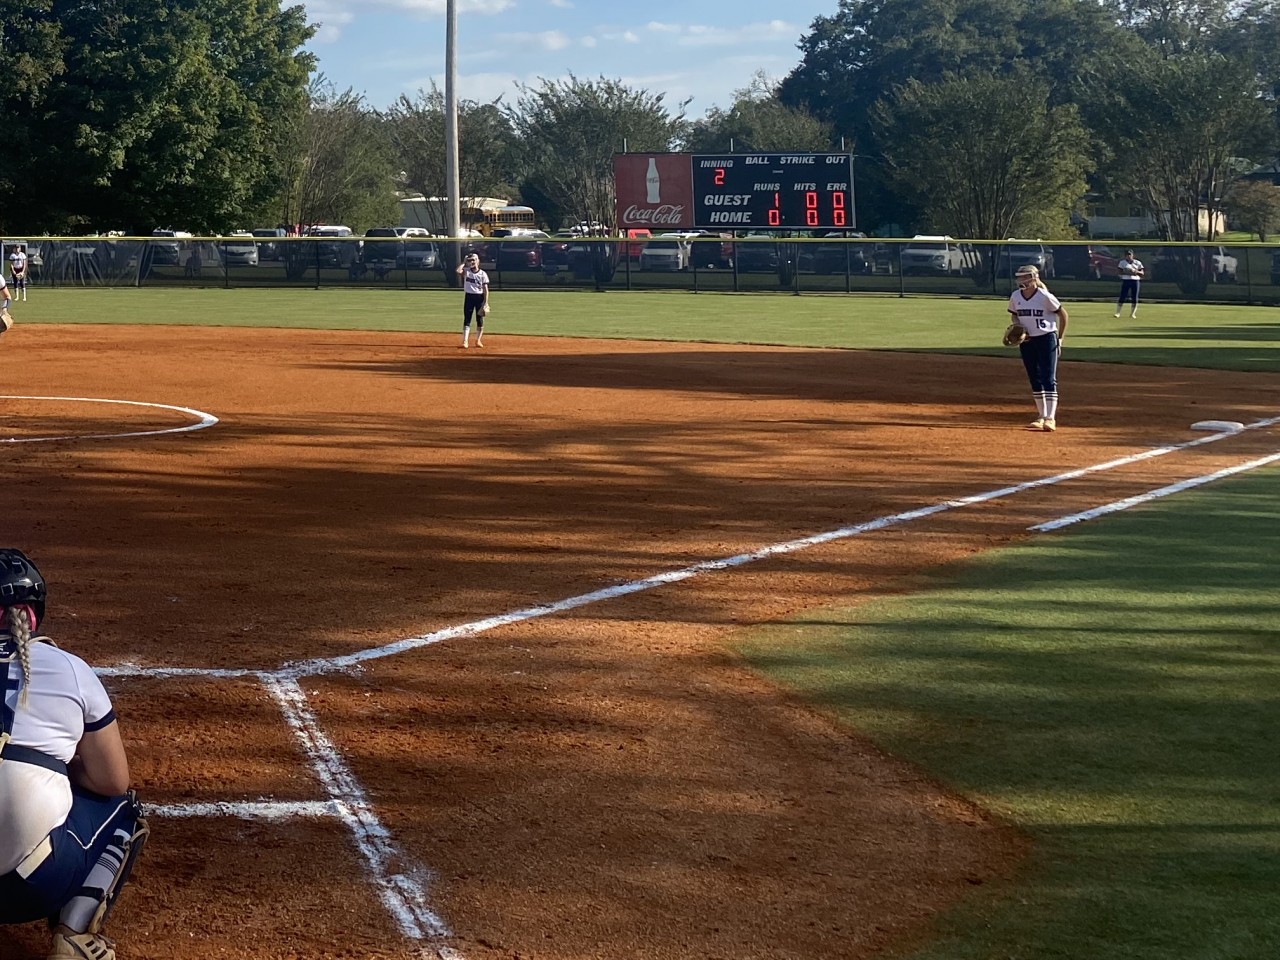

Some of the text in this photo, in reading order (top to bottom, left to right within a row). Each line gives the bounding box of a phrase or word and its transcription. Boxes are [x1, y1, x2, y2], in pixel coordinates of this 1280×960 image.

[700, 160, 734, 168] INNING
[745, 156, 847, 165] BALL STRIKE OUT
[714, 169, 725, 185] 2
[753, 183, 848, 191] RUNS HITS ERR
[704, 194, 752, 206] GUEST
[806, 192, 817, 208] 0
[833, 192, 844, 208] 0
[709, 210, 845, 226] HOME 0 0 0
[1036, 319, 1046, 328] 15
